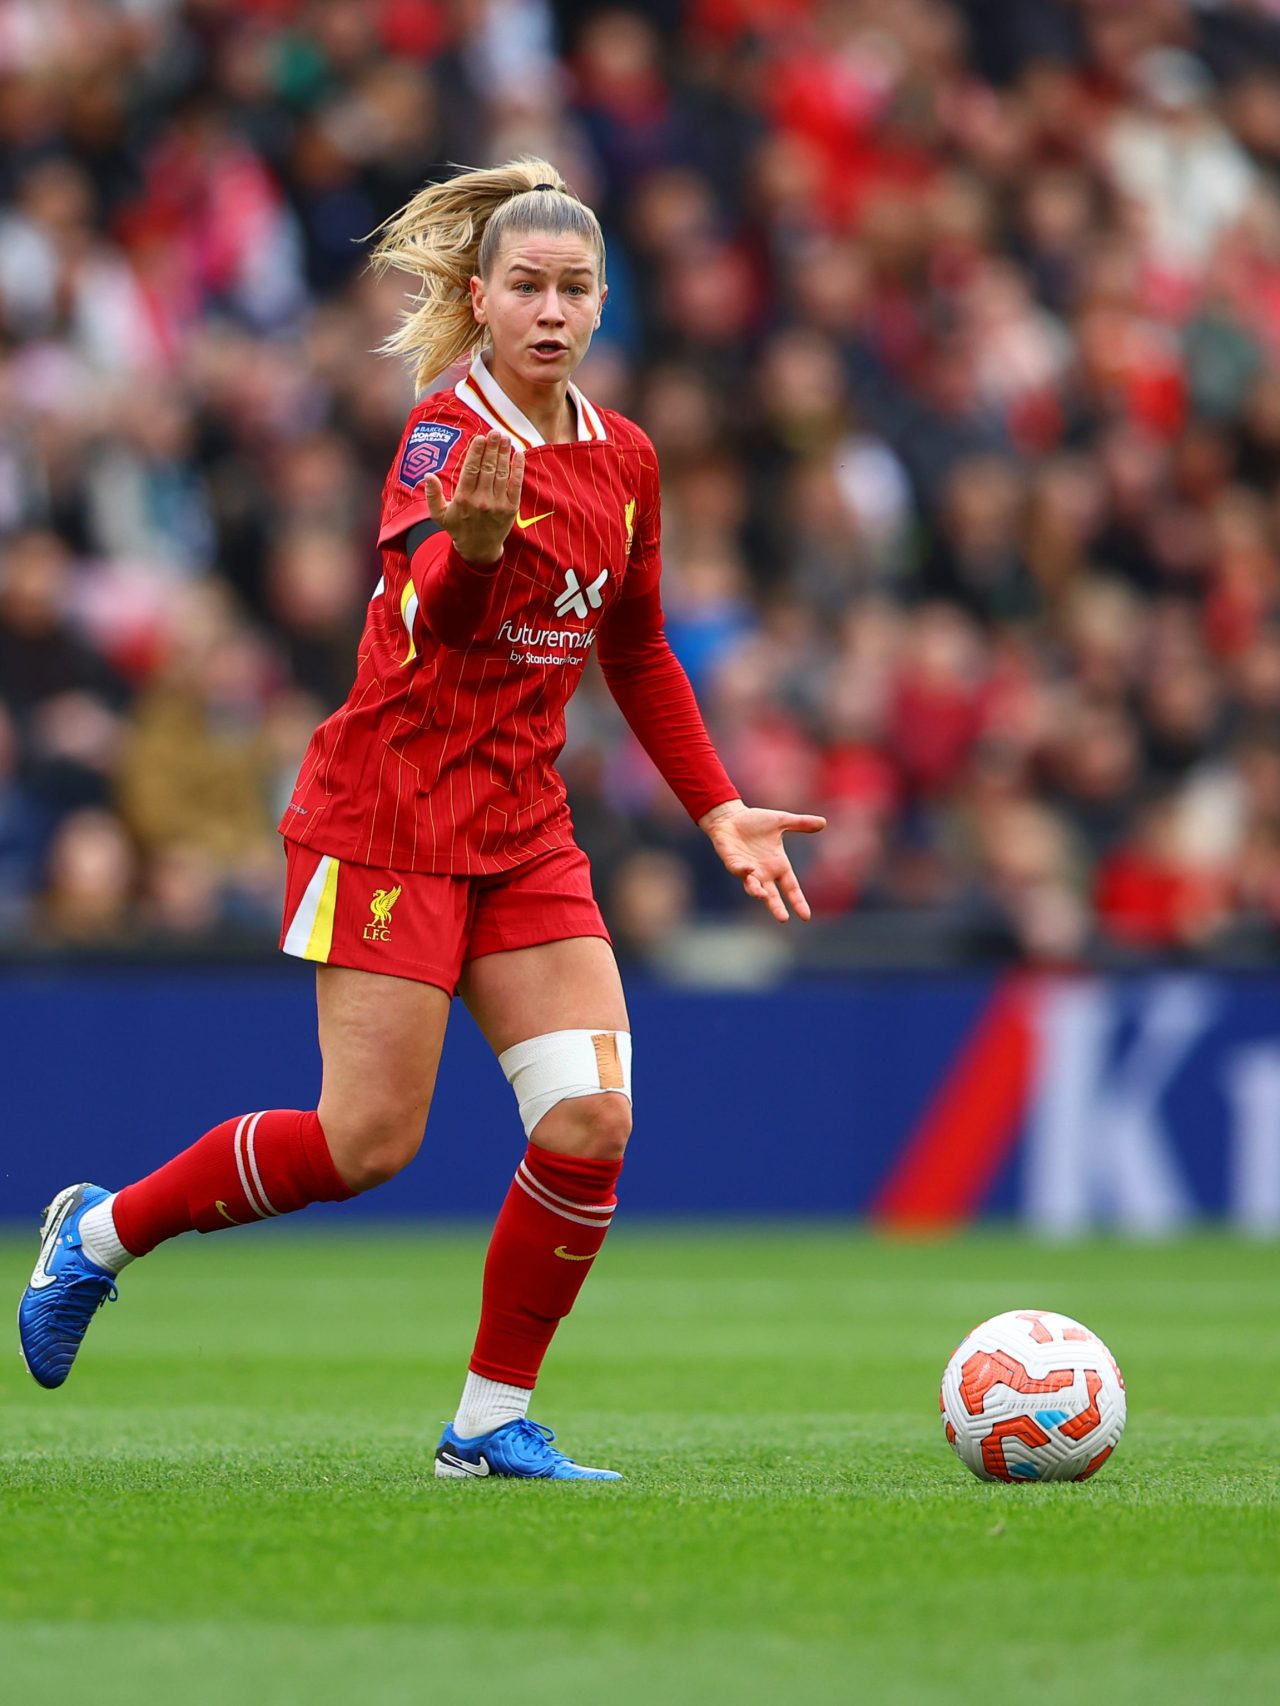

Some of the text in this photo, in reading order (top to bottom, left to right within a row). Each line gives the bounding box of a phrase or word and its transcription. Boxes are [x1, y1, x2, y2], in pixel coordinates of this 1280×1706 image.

[420, 426, 455, 437] BARCLAYS
[510, 650, 525, 665] by
[525, 651, 565, 666] Standar
